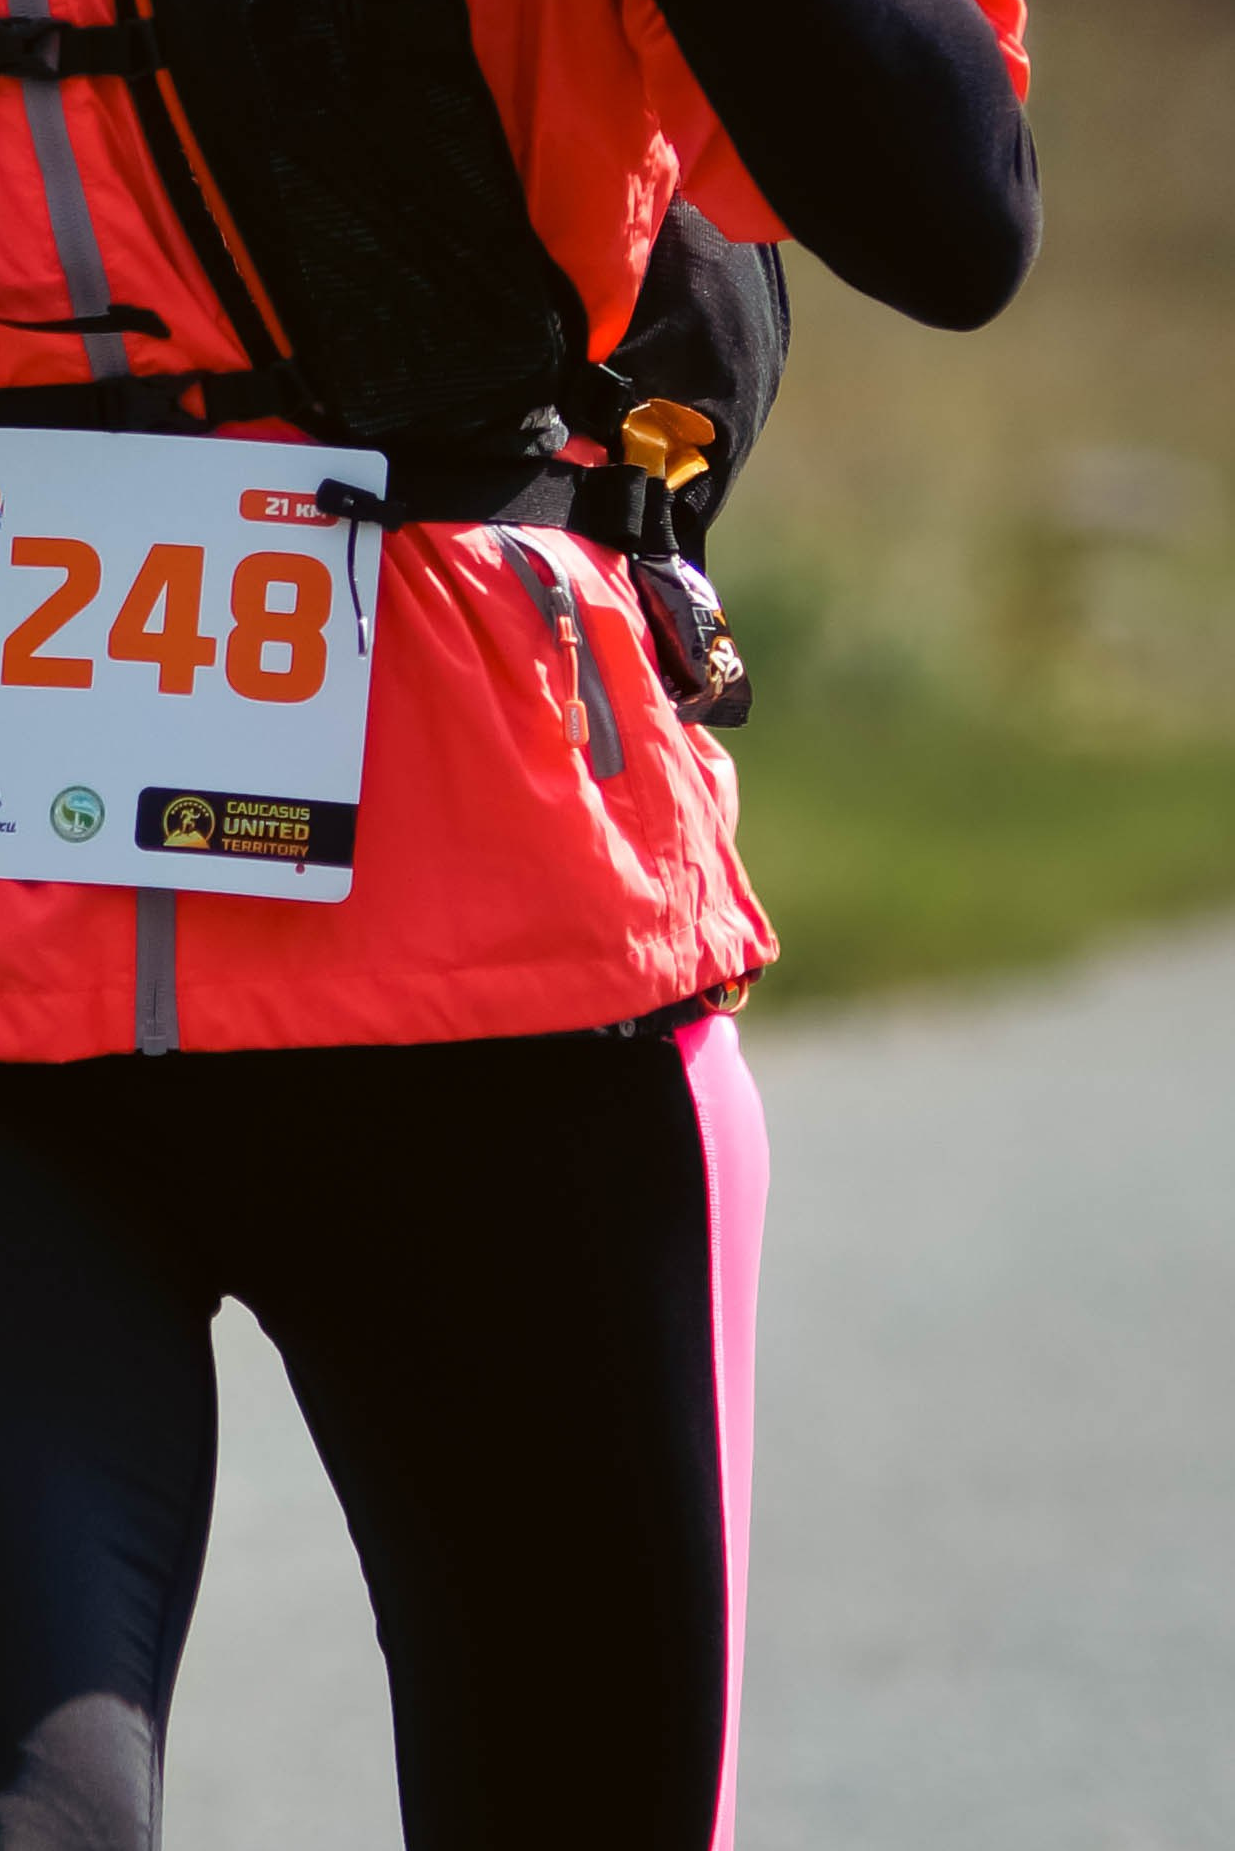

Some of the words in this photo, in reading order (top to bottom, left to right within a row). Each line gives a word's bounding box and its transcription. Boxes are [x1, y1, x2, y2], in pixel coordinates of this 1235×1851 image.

[264, 496, 289, 517] 21
[1, 536, 333, 703] 248
[226, 801, 311, 821] CAUCASUS
[223, 817, 310, 841] UNITED
[221, 837, 310, 858] TERRITORY
